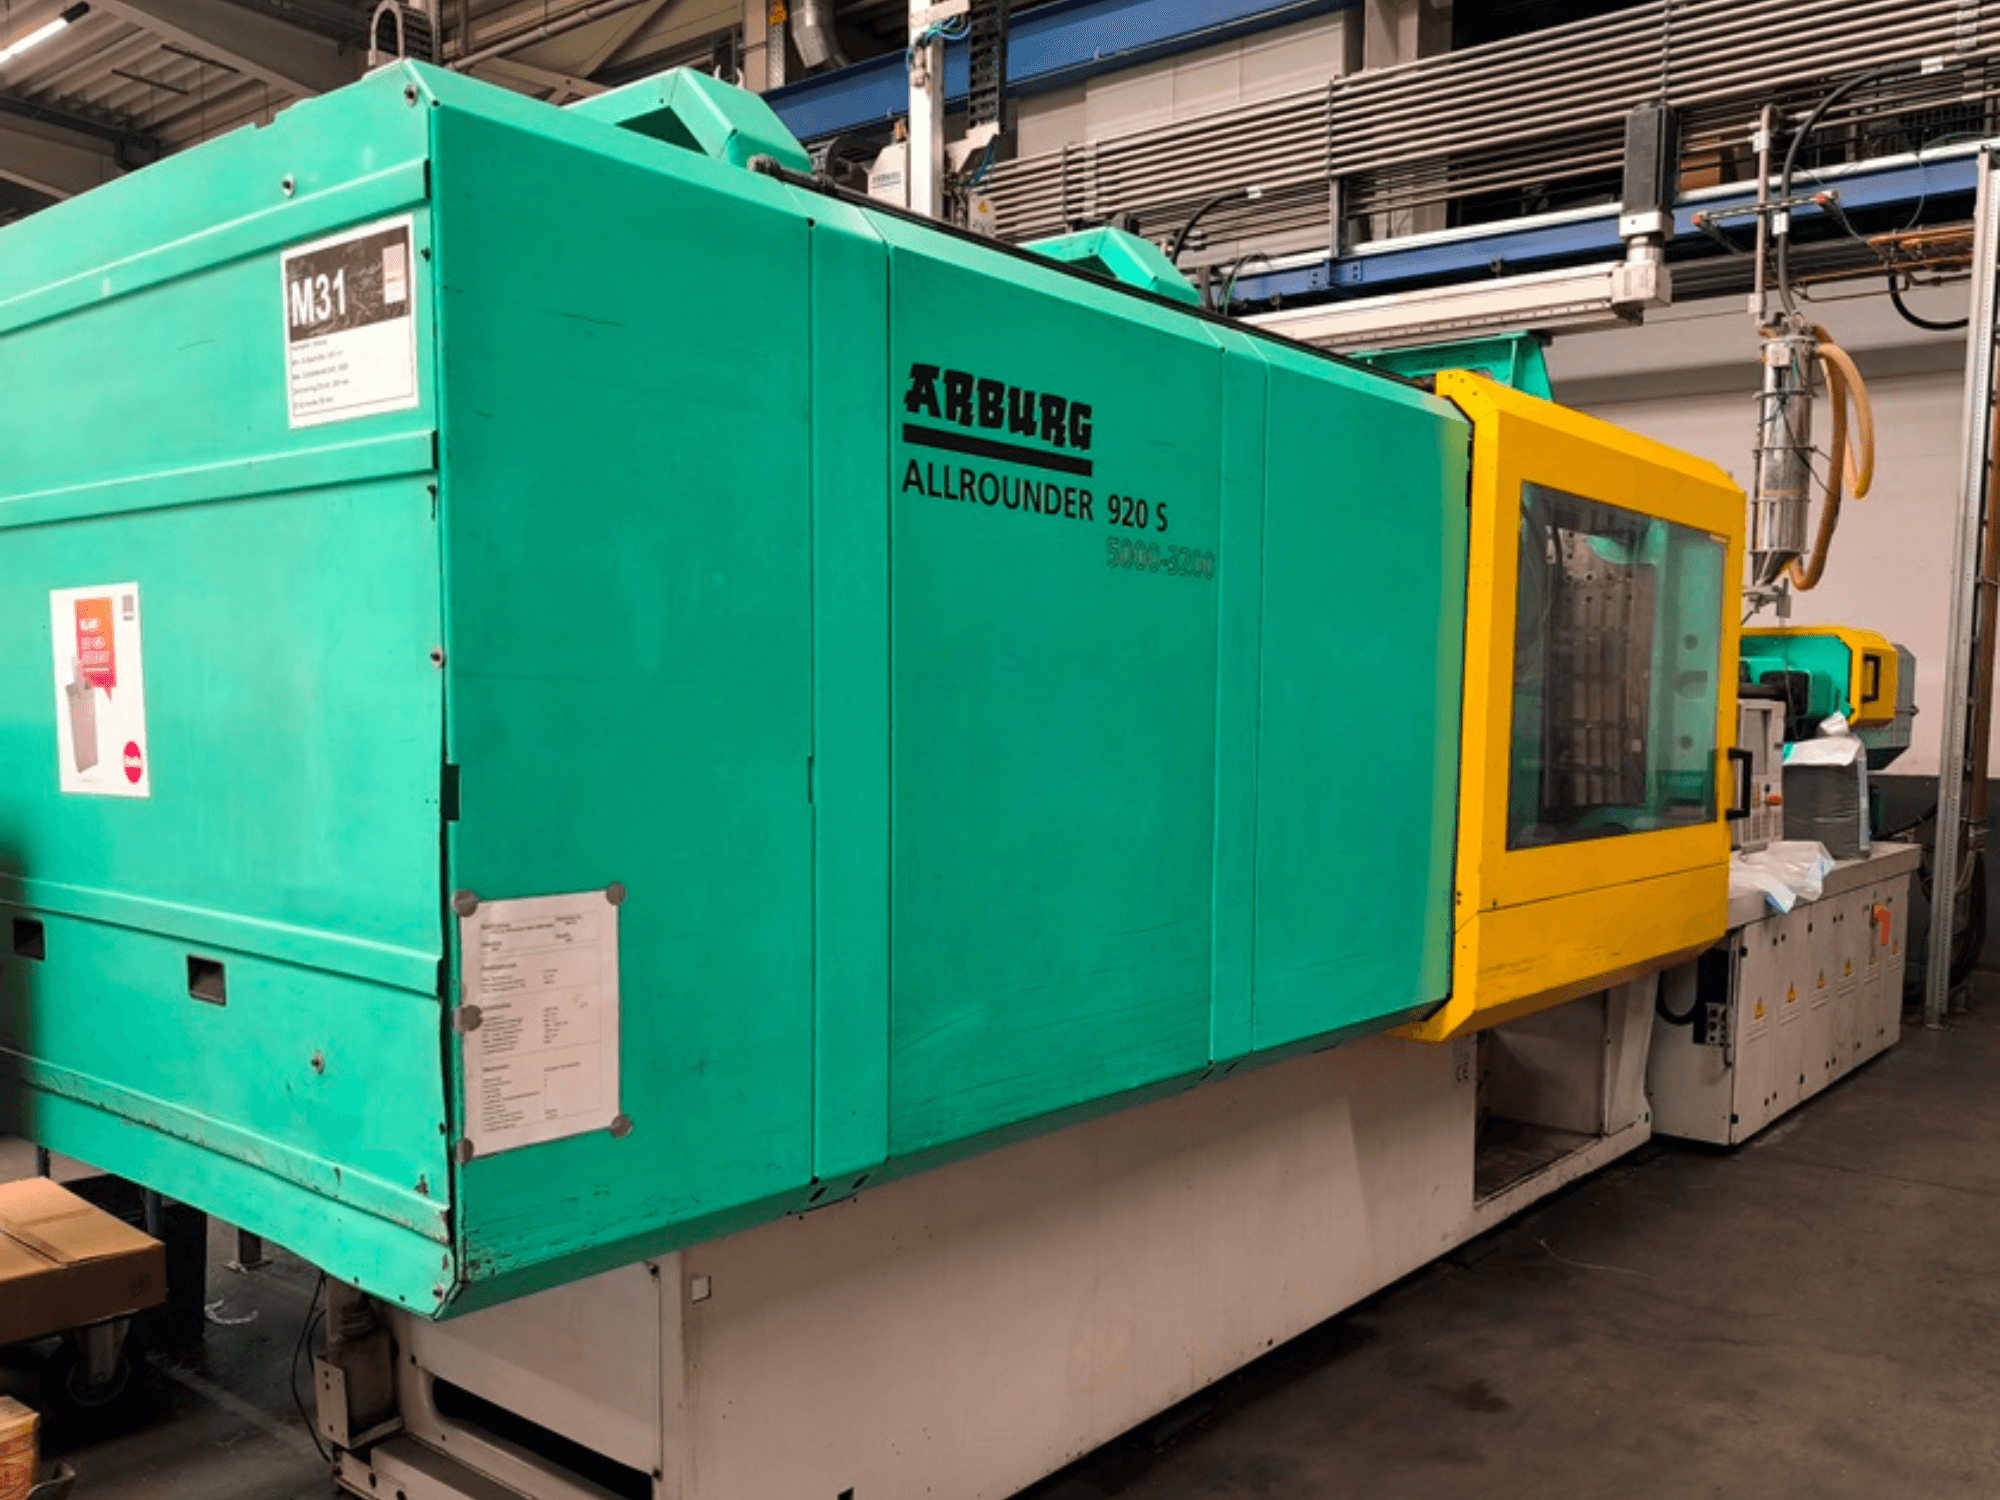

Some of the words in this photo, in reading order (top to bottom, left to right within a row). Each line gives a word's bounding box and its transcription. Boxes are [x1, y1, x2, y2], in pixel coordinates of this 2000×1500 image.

[291, 268, 346, 328] M31
[903, 362, 1093, 451] ARBURG
[902, 458, 1094, 522] ALLROUNDER
[1107, 494, 1148, 530] 920
[1156, 502, 1169, 532] S
